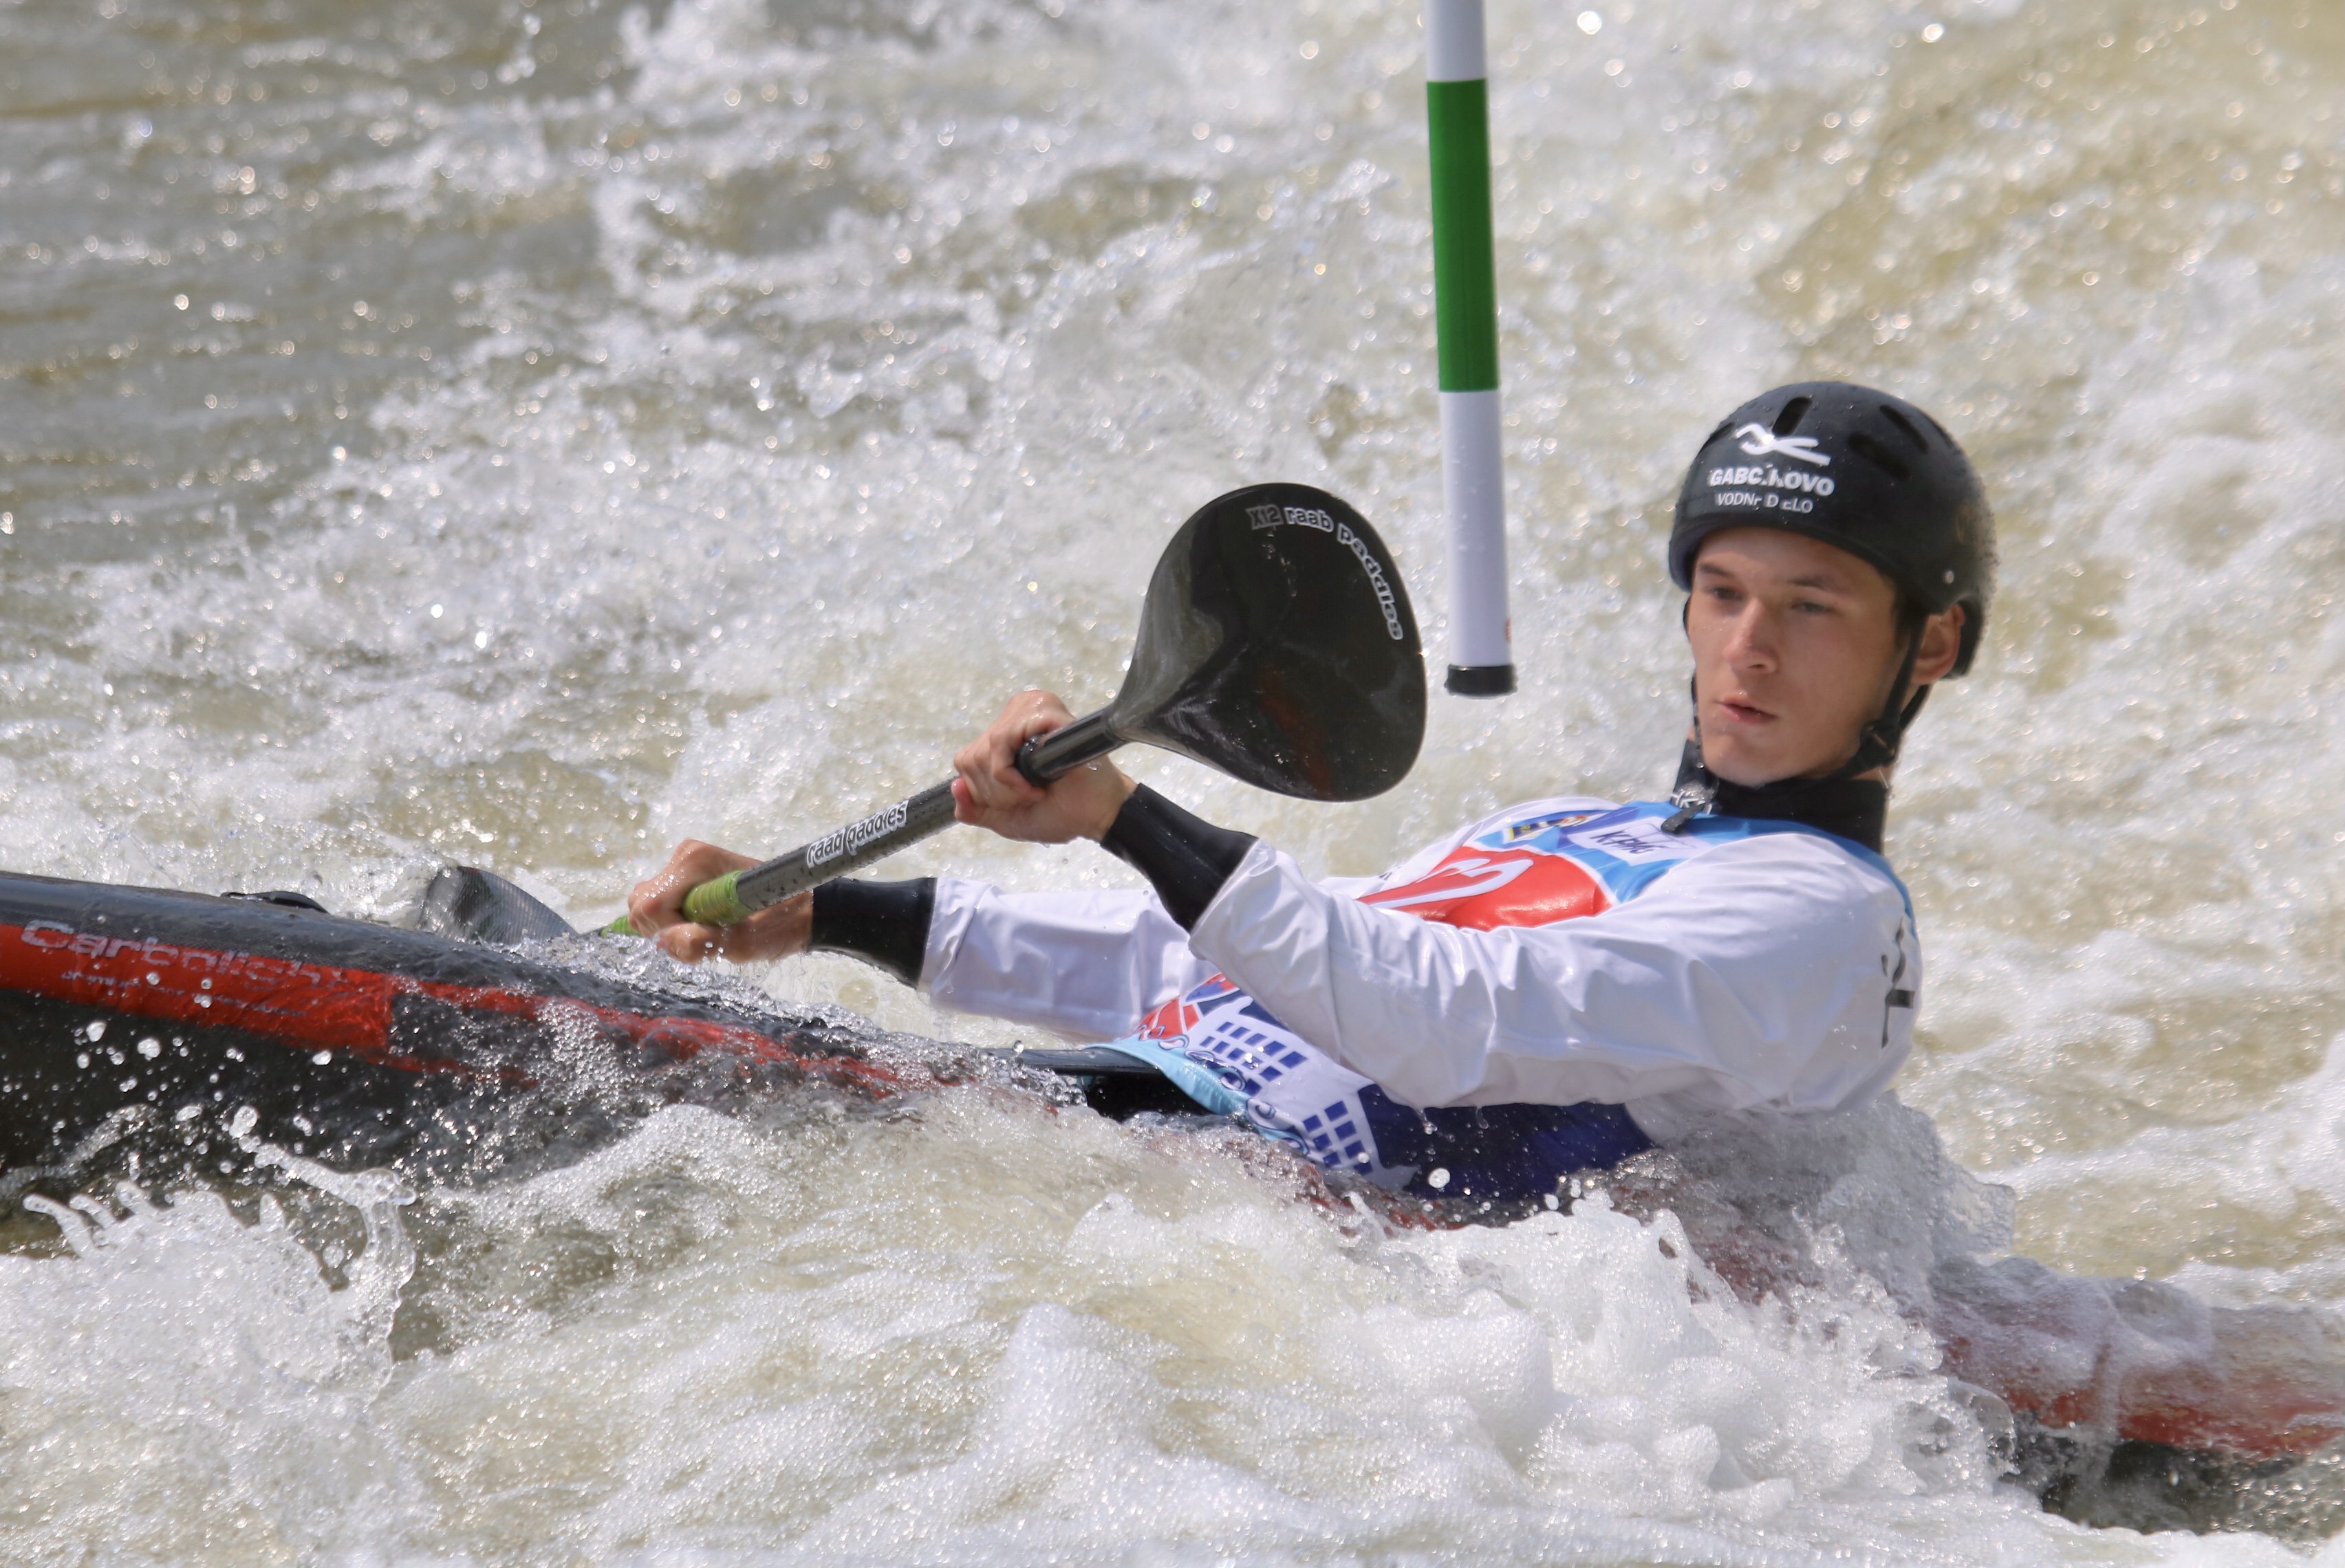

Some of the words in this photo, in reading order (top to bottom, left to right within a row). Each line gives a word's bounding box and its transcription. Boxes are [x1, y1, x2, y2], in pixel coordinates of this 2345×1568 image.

[1284, 507, 1334, 533] raab
[1337, 523, 1404, 640] paddles
[807, 827, 846, 869] raab
